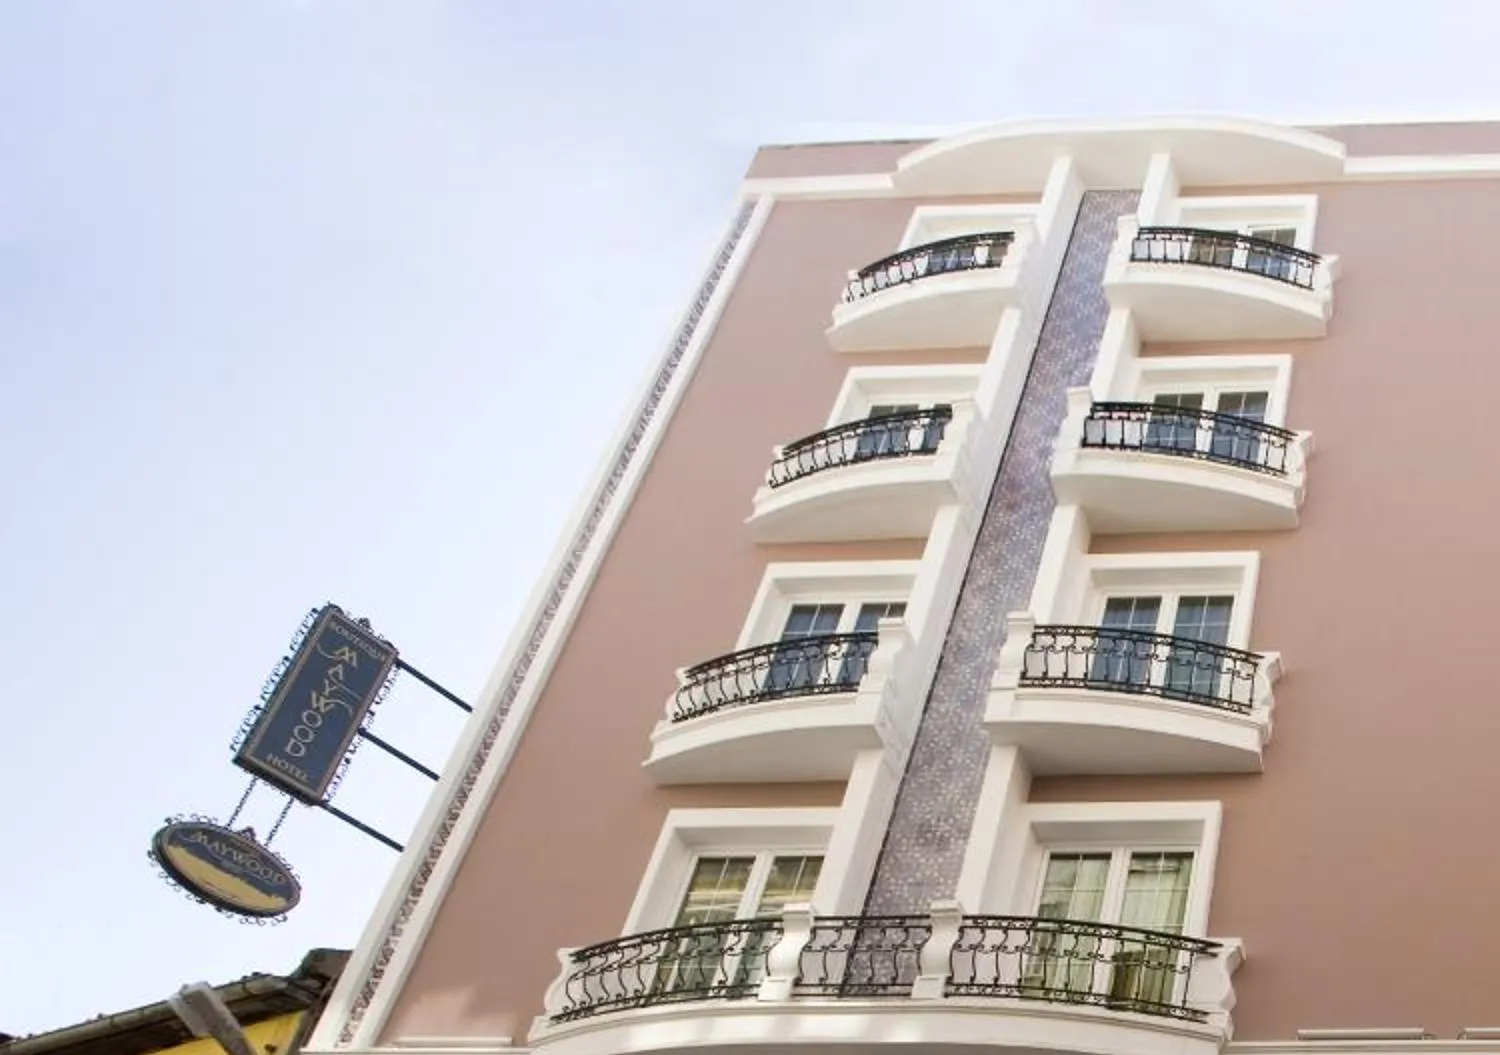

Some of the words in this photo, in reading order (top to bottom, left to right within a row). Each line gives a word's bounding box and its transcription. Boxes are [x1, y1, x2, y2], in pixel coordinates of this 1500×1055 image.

[284, 645, 361, 758] MAYWOOD
[265, 752, 311, 784] HOTEL
[186, 830, 289, 887] MAYWOOD
